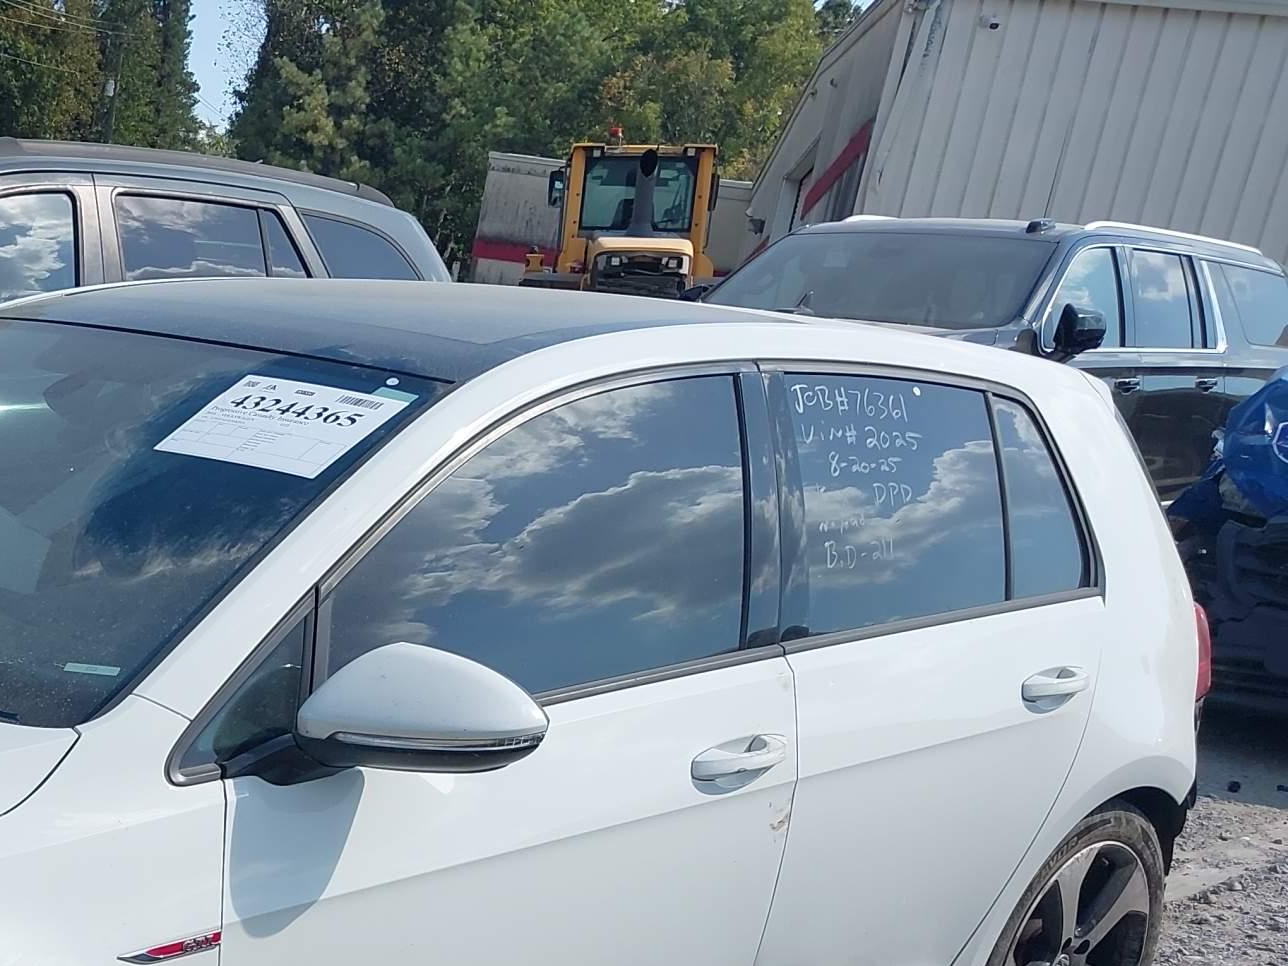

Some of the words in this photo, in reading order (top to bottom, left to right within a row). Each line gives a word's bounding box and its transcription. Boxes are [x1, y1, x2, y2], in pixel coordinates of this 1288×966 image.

[230, 393, 365, 427] 43244365
[864, 425, 923, 450] 2025
[828, 450, 902, 477] 8-20-25
[872, 482, 912, 506] DPD
